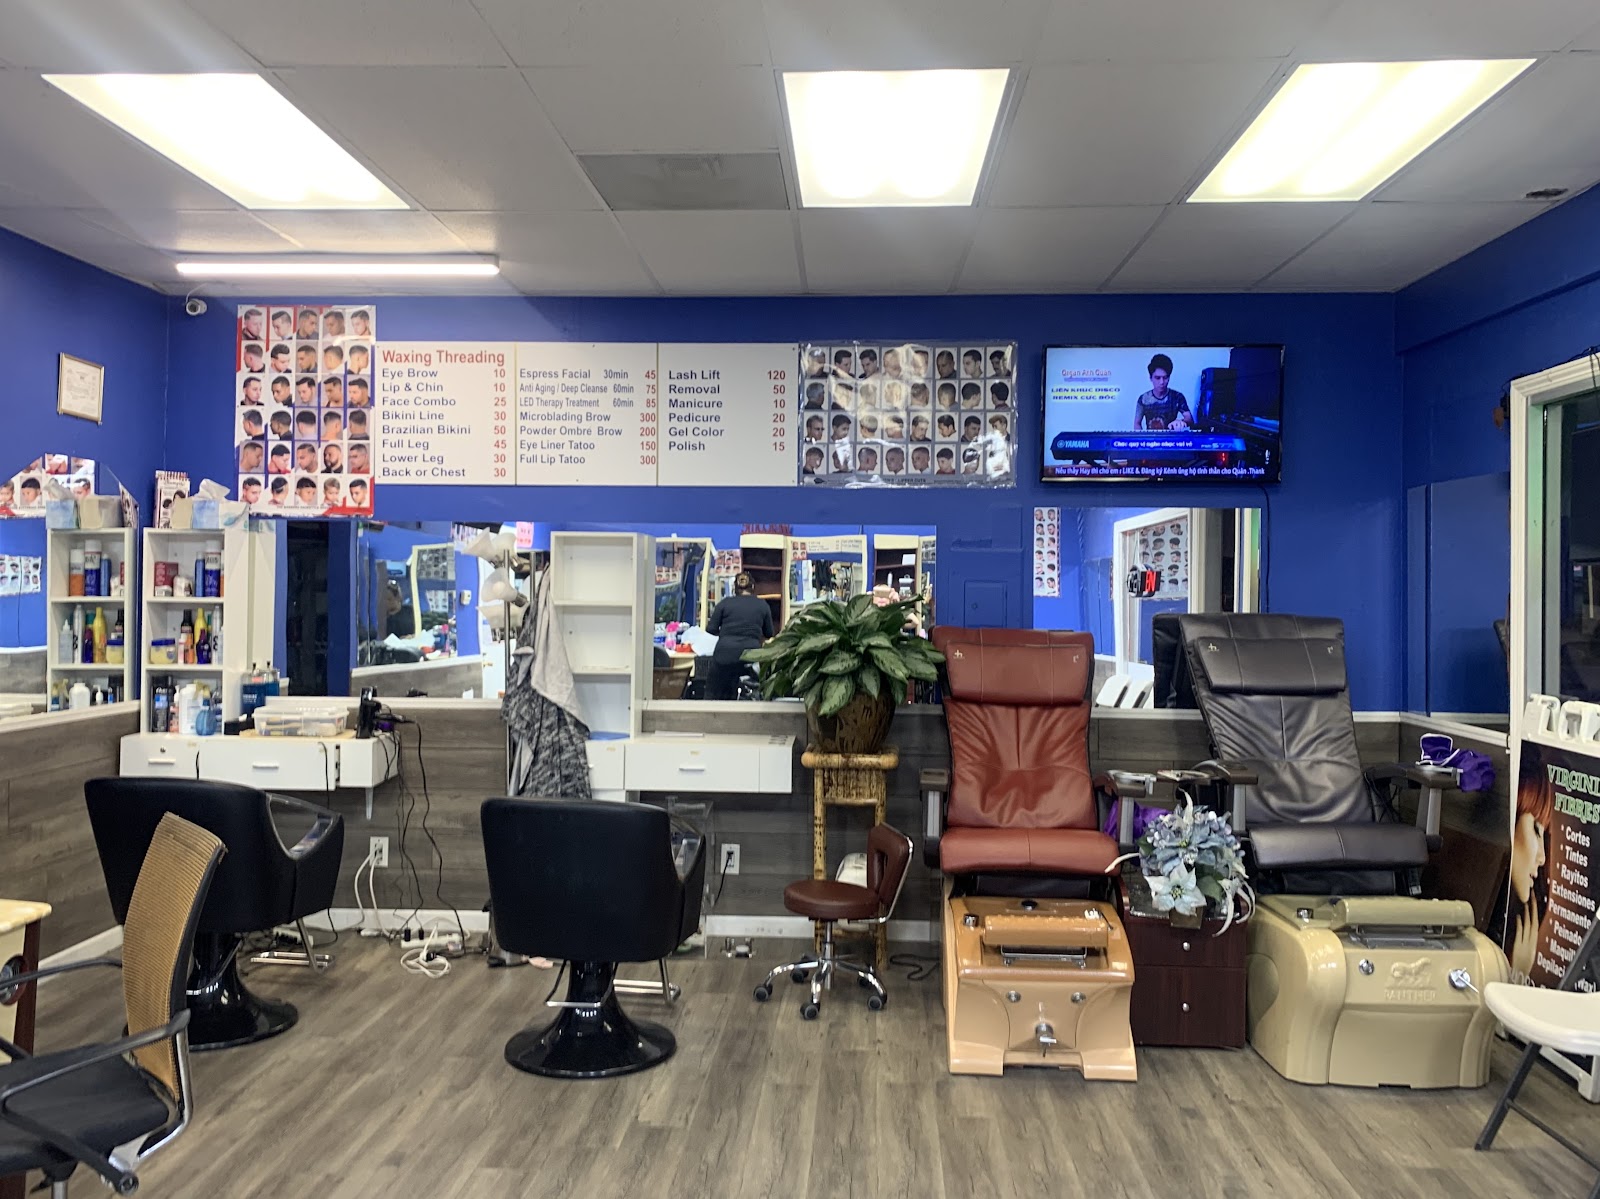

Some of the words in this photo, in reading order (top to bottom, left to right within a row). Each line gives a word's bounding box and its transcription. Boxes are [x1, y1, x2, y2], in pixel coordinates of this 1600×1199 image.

[382, 349, 432, 367] Waxing
[435, 349, 505, 367] Threading
[382, 368, 404, 380] Eye
[407, 368, 438, 378] Brow
[493, 367, 506, 379] 10
[519, 368, 559, 381] Espress
[562, 368, 591, 379] Facial
[603, 368, 629, 380] 30min
[644, 369, 656, 381] 45
[668, 369, 698, 380] Lash
[701, 369, 721, 380] Lift
[767, 369, 786, 381] 120
[382, 382, 401, 394] Lip
[403, 382, 413, 392] &
[416, 382, 444, 392] Chin
[493, 382, 506, 393] 10
[519, 383, 534, 392] Anti
[534, 383, 556, 394] Aging
[560, 383, 579, 394] Deep
[579, 383, 609, 393] Cleanse
[612, 383, 635, 394] 60min
[645, 383, 656, 395] 75
[668, 383, 721, 395] Removal
[772, 384, 786, 395] 50
[382, 396, 410, 406] Face
[413, 396, 457, 406] Combo
[493, 396, 507, 407] 25
[519, 397, 535, 407] LED
[535, 397, 565, 409] Therapy
[564, 398, 601, 407] Treatment
[612, 397, 634, 408] 60min
[645, 397, 656, 409] 85
[668, 398, 723, 409] Manicure
[773, 398, 786, 409] 10
[382, 410, 416, 420] Bikini
[419, 410, 445, 421] Line
[493, 410, 507, 421] 30
[519, 411, 583, 424] Microblading
[585, 411, 612, 422] Brow
[639, 411, 656, 423] 300
[668, 412, 721, 423] Pedicure
[772, 412, 786, 424] 20
[382, 424, 434, 435] Brazilian
[437, 424, 471, 435] Bikini
[493, 424, 507, 436] 50
[519, 425, 557, 435] Powder
[597, 425, 623, 436] Brow
[639, 426, 656, 437] 200
[668, 426, 689, 437] Gel
[691, 426, 725, 437] Color
[772, 426, 786, 438] 20
[382, 438, 404, 449] Full
[407, 438, 430, 451] Leg
[493, 439, 507, 450] 45
[519, 439, 538, 452] Eye
[540, 439, 566, 450] Liner
[568, 439, 596, 450] Tatoo
[640, 440, 656, 452] 150
[668, 440, 706, 451] Polish
[772, 441, 786, 452] 15
[382, 452, 419, 463] Lower
[422, 453, 444, 465] Leg
[493, 453, 507, 464] 30
[519, 453, 538, 464] Full
[540, 454, 556, 466] Lip
[558, 453, 586, 464] Tatoo
[639, 454, 656, 466] 300
[382, 466, 412, 477] Back
[415, 469, 428, 477] or
[431, 466, 466, 477] Chest
[493, 467, 507, 478] 30
[1122, 467, 1134, 475] LIKE
[1565, 825, 1591, 848] Cortes
[1565, 846, 1588, 868] Tintes
[1561, 864, 1589, 889] Rayitos
[1551, 880, 1596, 912] Extensiones
[1549, 937, 1576, 962] Maquil
[1537, 951, 1566, 977] Depilaci
